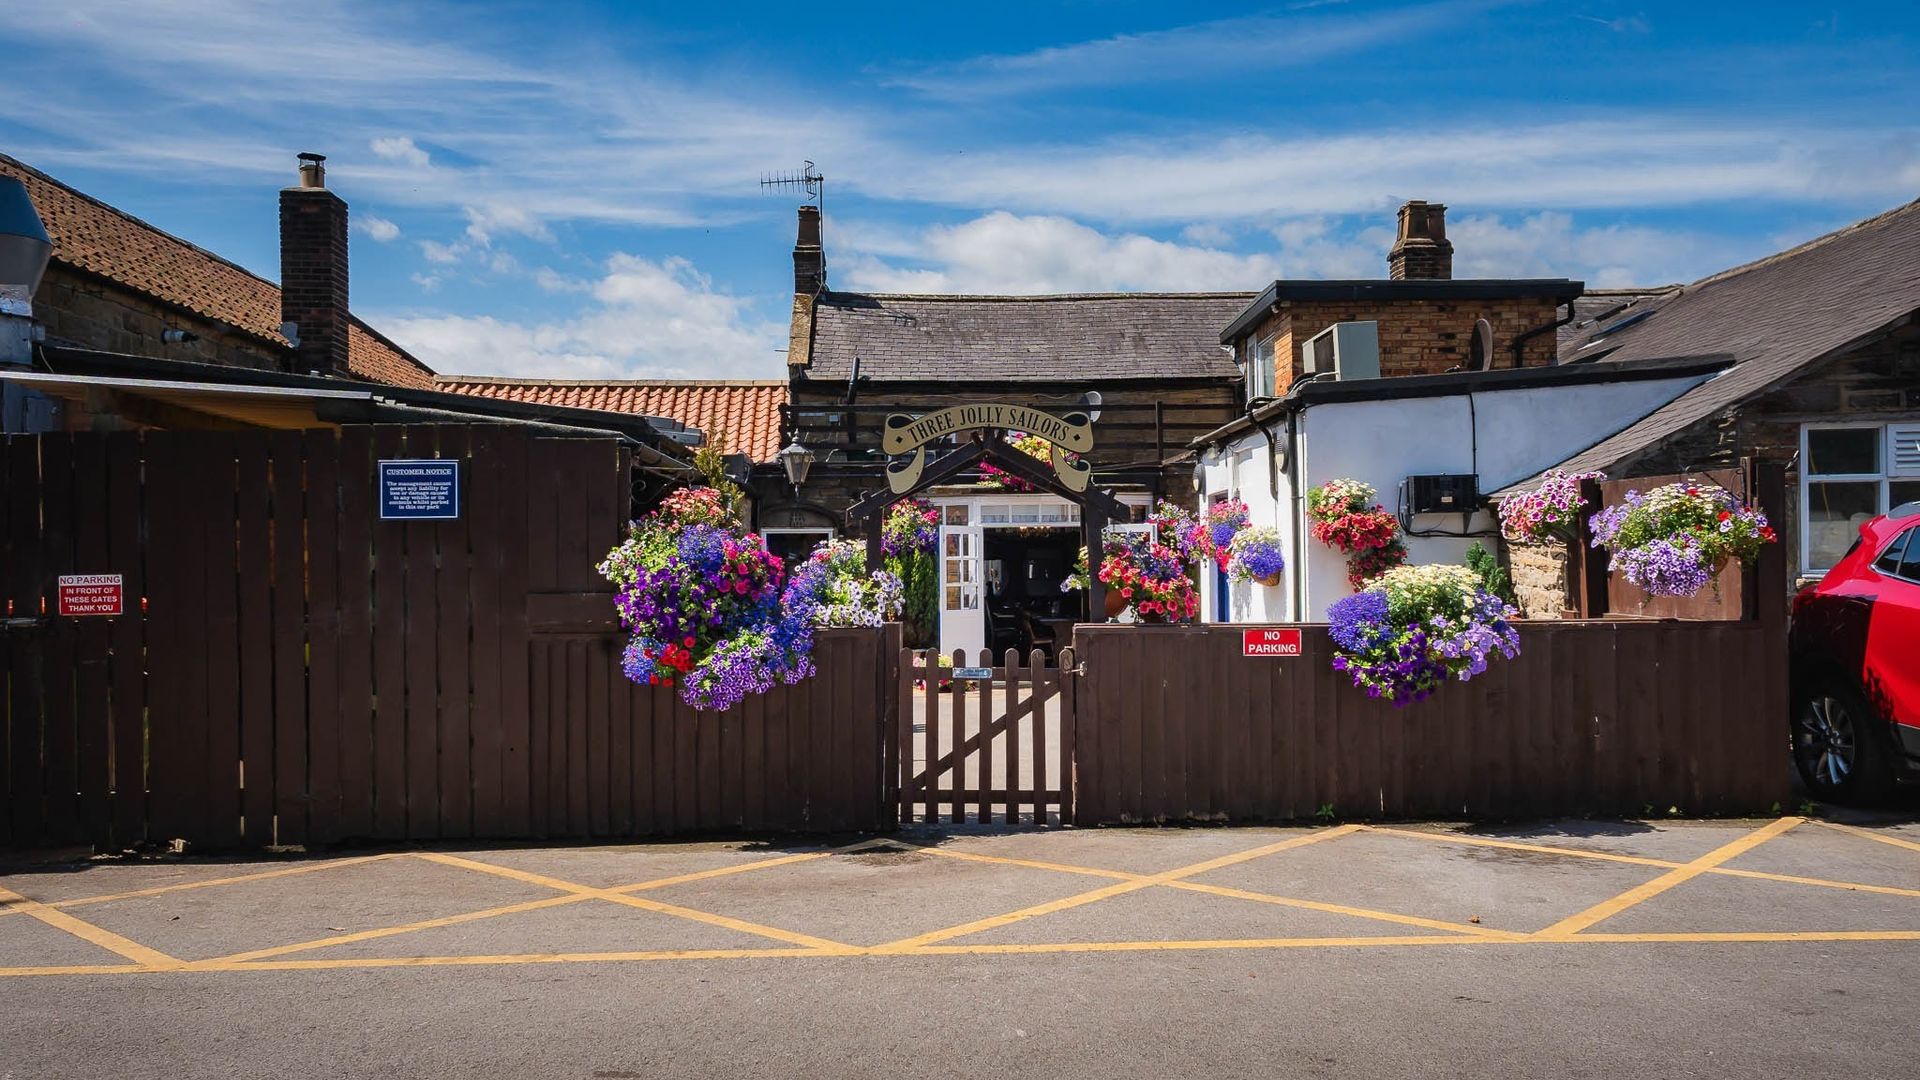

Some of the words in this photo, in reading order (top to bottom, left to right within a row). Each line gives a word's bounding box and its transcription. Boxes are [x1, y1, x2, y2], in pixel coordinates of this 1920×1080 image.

[907, 412, 955, 443] THREE
[960, 407, 1003, 426] JOLLY
[1009, 409, 1069, 442] SAILORS
[1264, 632, 1280, 640] NO
[1248, 644, 1296, 653] PARKING
